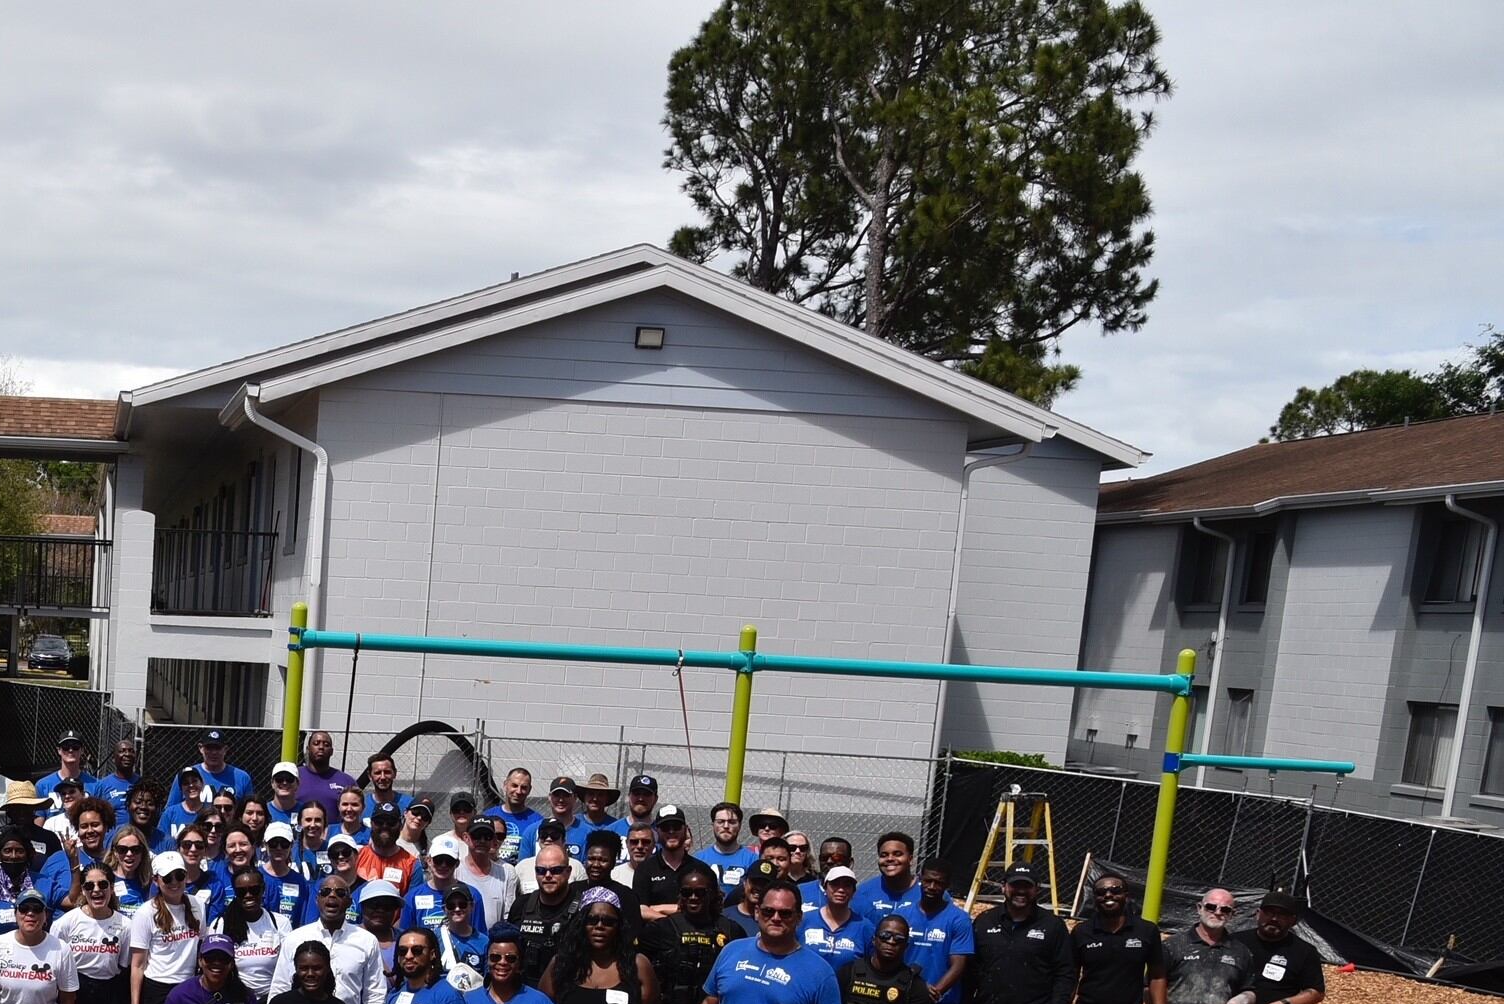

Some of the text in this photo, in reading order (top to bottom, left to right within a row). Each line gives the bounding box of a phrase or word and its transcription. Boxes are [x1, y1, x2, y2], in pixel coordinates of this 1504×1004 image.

[520, 924, 544, 934] POLICE
[0, 969, 53, 981] VOLUNTEARS
[852, 986, 881, 997] POLICE
